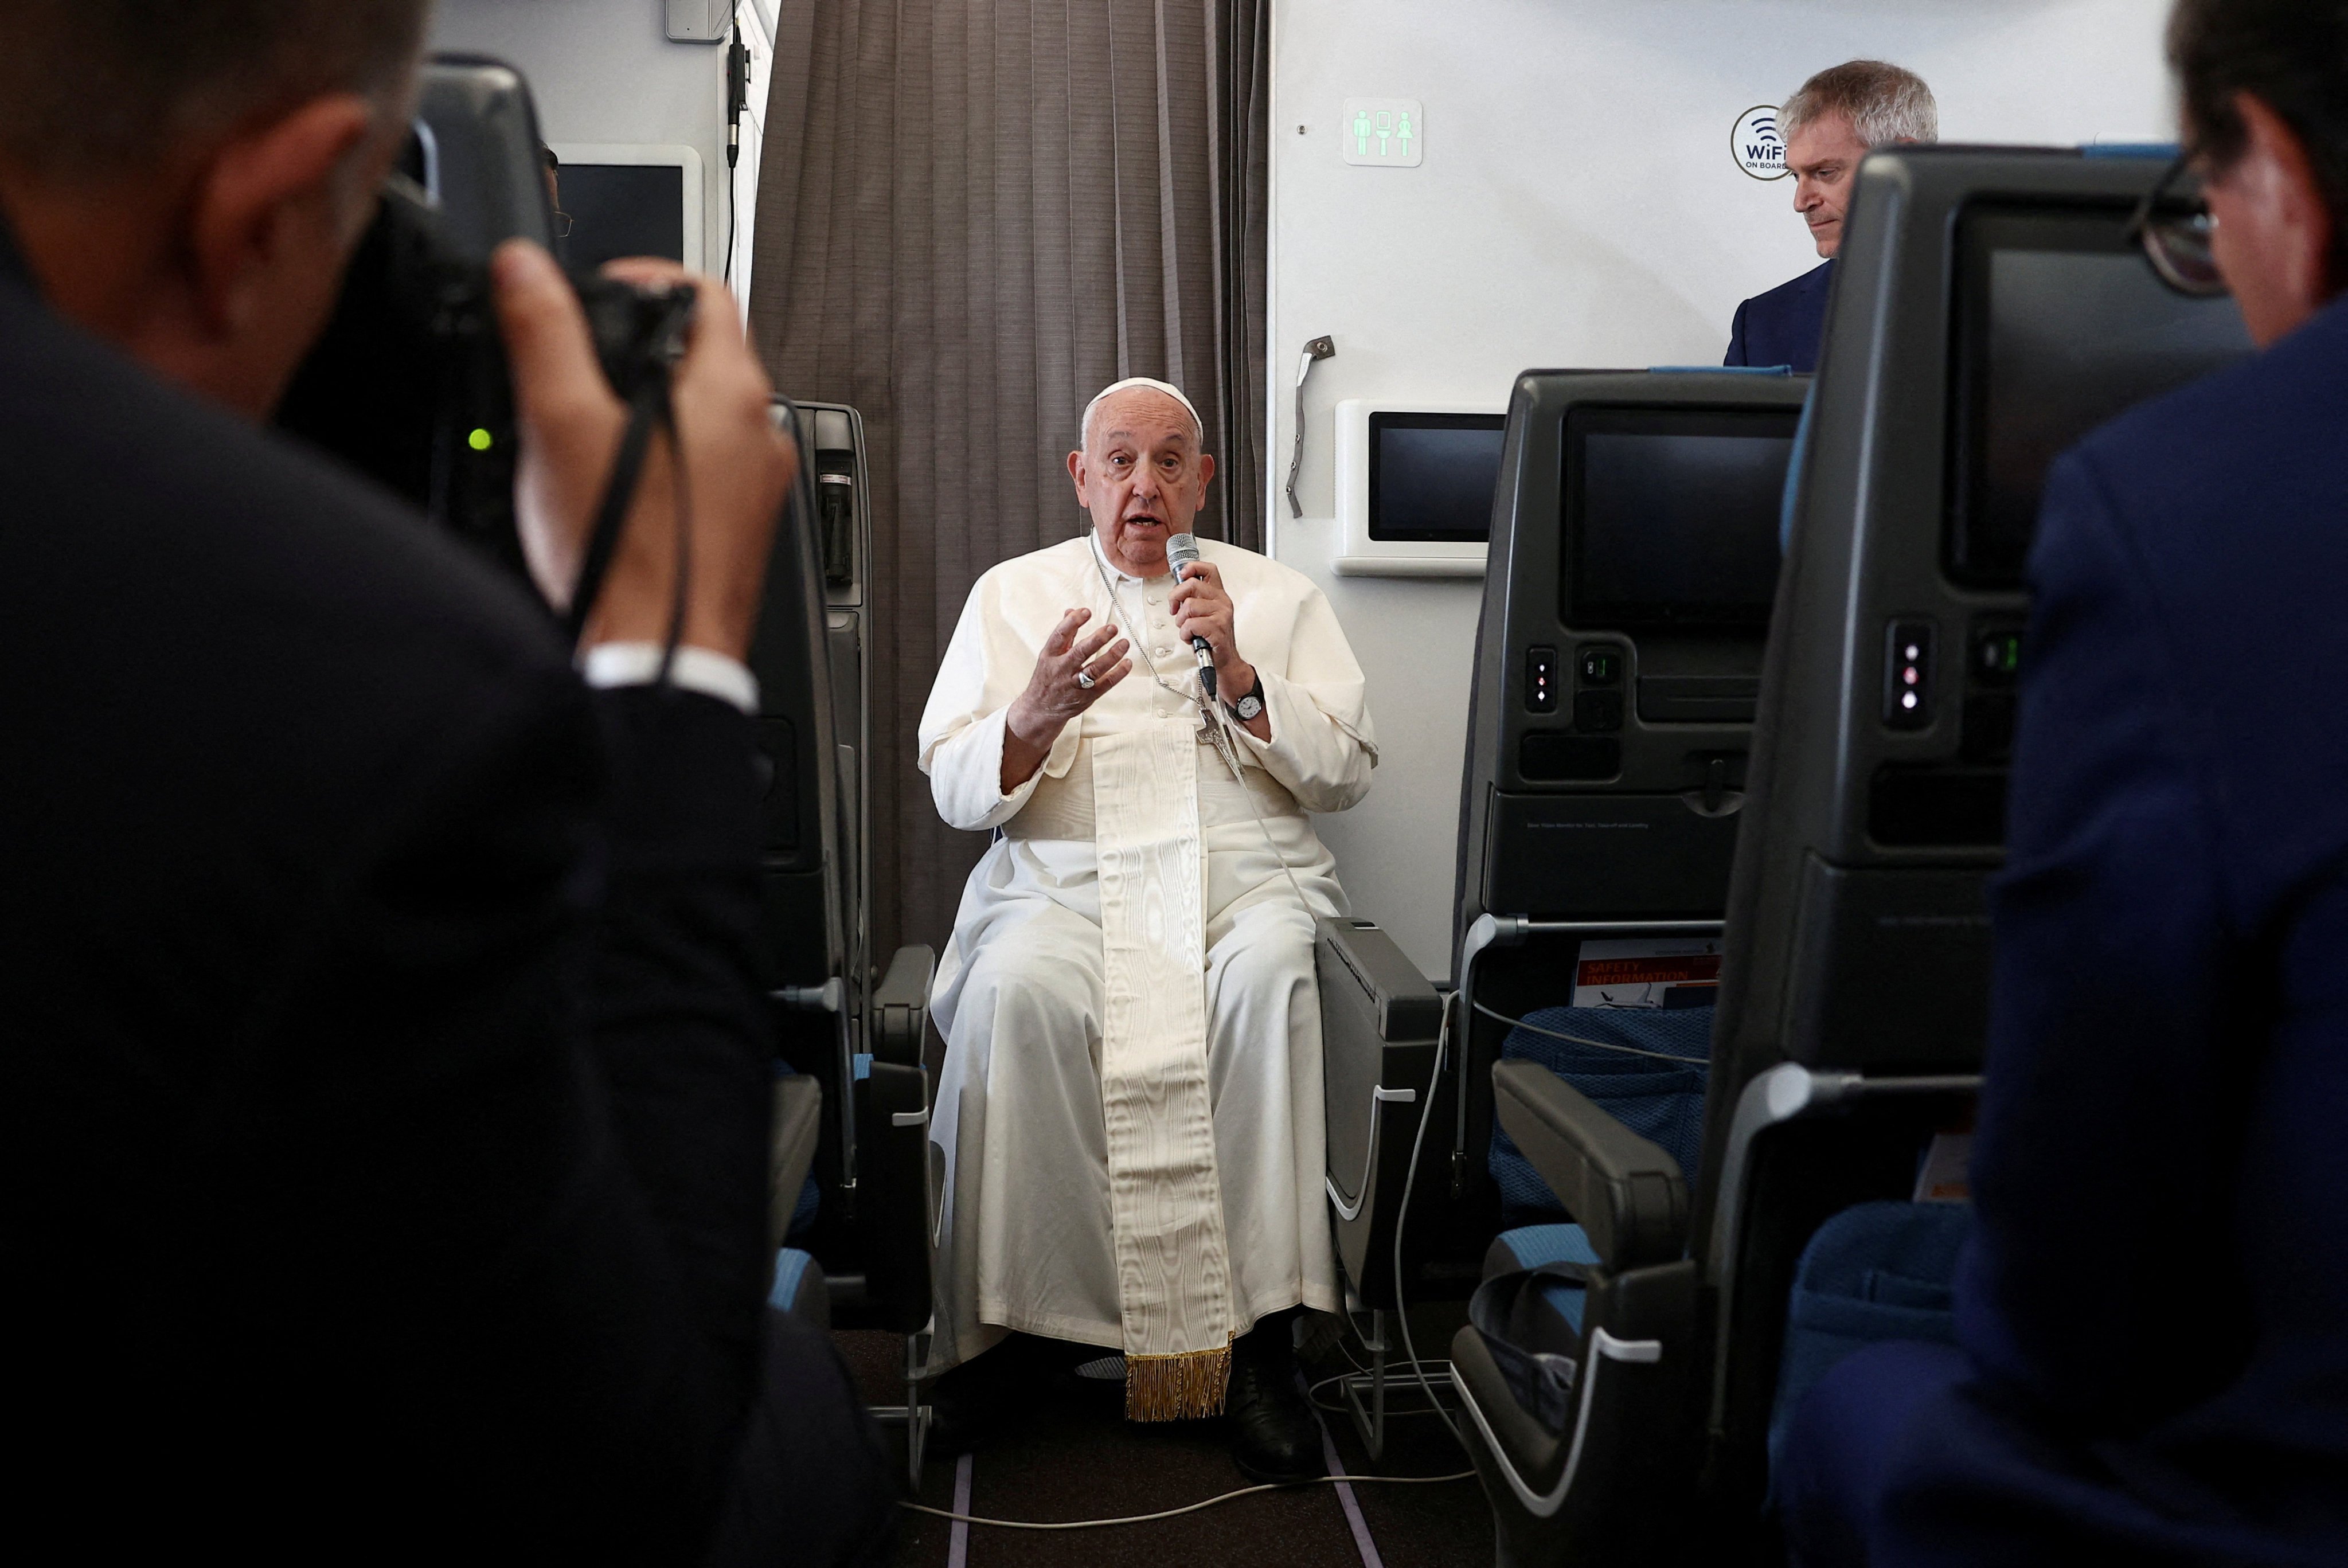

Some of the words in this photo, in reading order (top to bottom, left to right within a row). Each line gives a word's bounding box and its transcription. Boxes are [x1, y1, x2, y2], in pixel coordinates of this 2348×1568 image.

[1746, 144, 1787, 160] WiFi
[1587, 961, 1642, 974] SAFETY
[1587, 971, 1688, 986] INFORMATION
